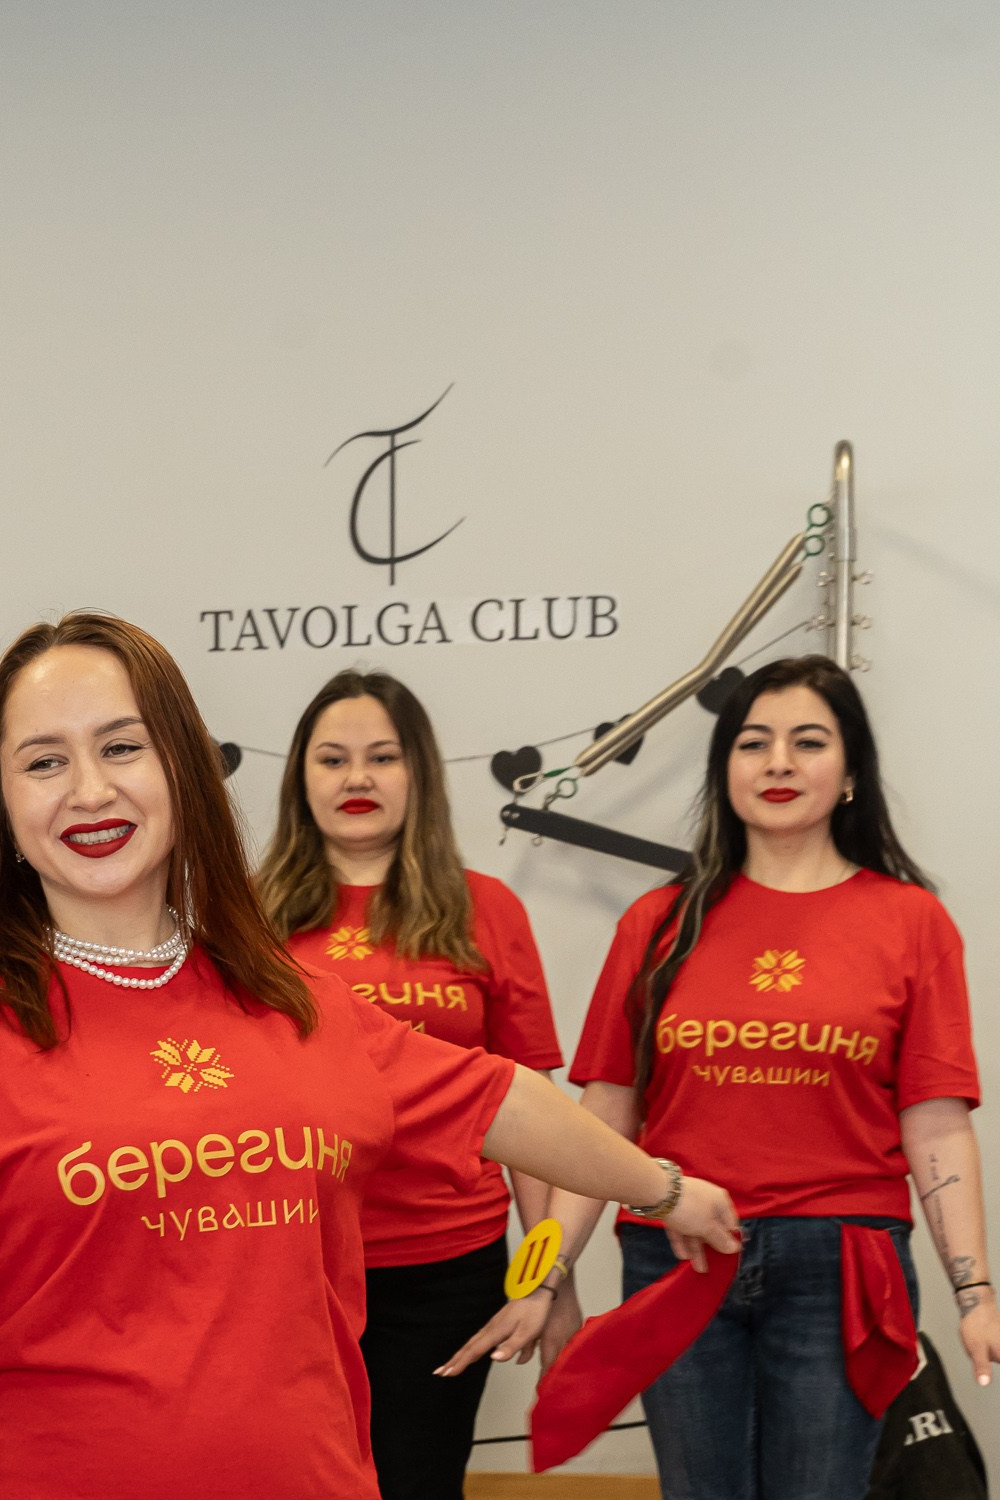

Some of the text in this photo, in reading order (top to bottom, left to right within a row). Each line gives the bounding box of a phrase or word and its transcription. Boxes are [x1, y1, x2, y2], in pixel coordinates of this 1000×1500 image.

[200, 595, 619, 652] TAVOLGA CLUB
[656, 1013, 879, 1065] берегиня
[692, 1065, 831, 1087] чувашии
[57, 1126, 352, 1206] берегиня
[517, 1235, 551, 1285] 11
